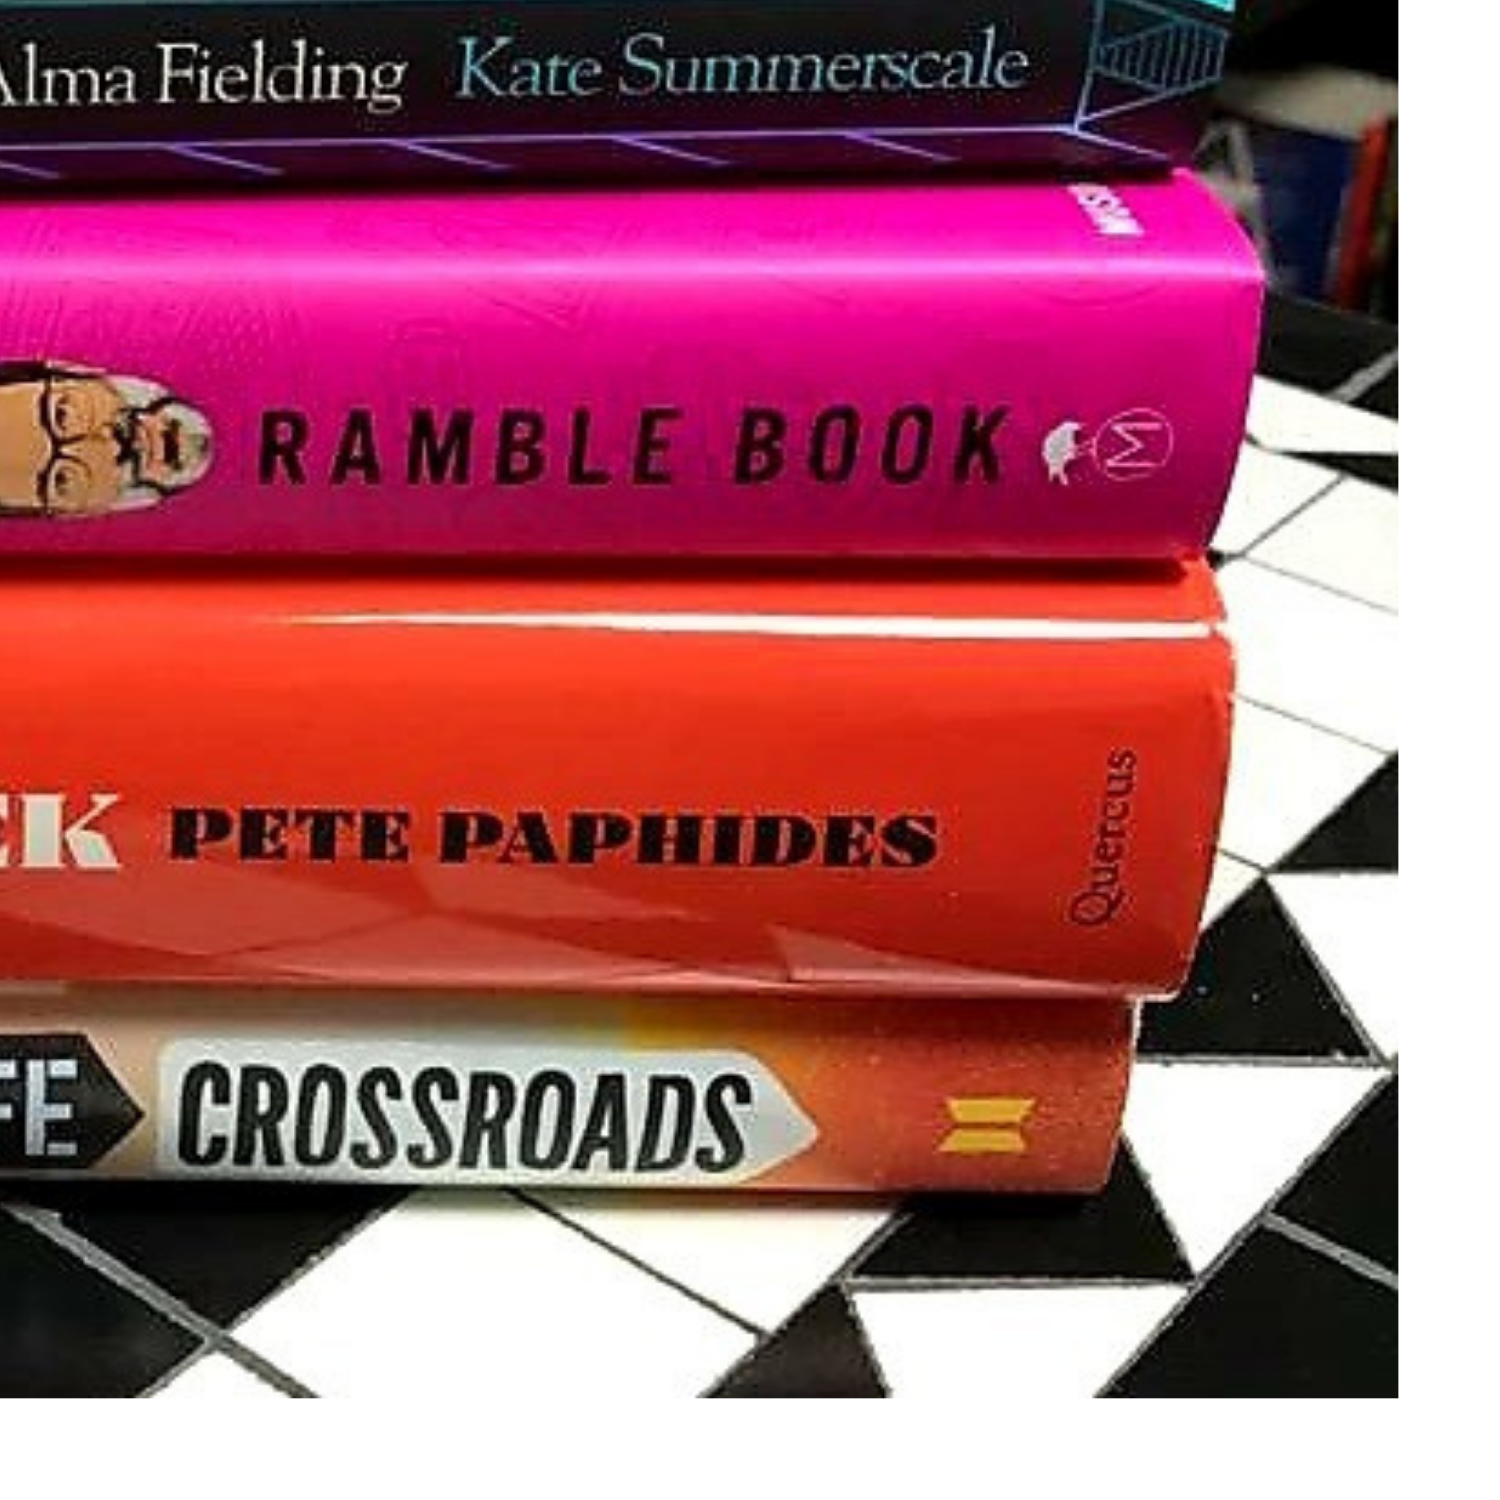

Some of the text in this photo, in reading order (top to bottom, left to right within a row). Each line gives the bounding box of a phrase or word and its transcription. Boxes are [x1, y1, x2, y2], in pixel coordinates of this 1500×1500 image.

[156, 35, 408, 115] Fielding
[456, 26, 1031, 99] Kate Summerscale
[256, 403, 1013, 487] RAMBLE BOOK
[168, 806, 939, 869] PETE PAPHIDES
[1068, 747, 1137, 929] Quercus
[177, 1060, 753, 1174] CROSSROADS
